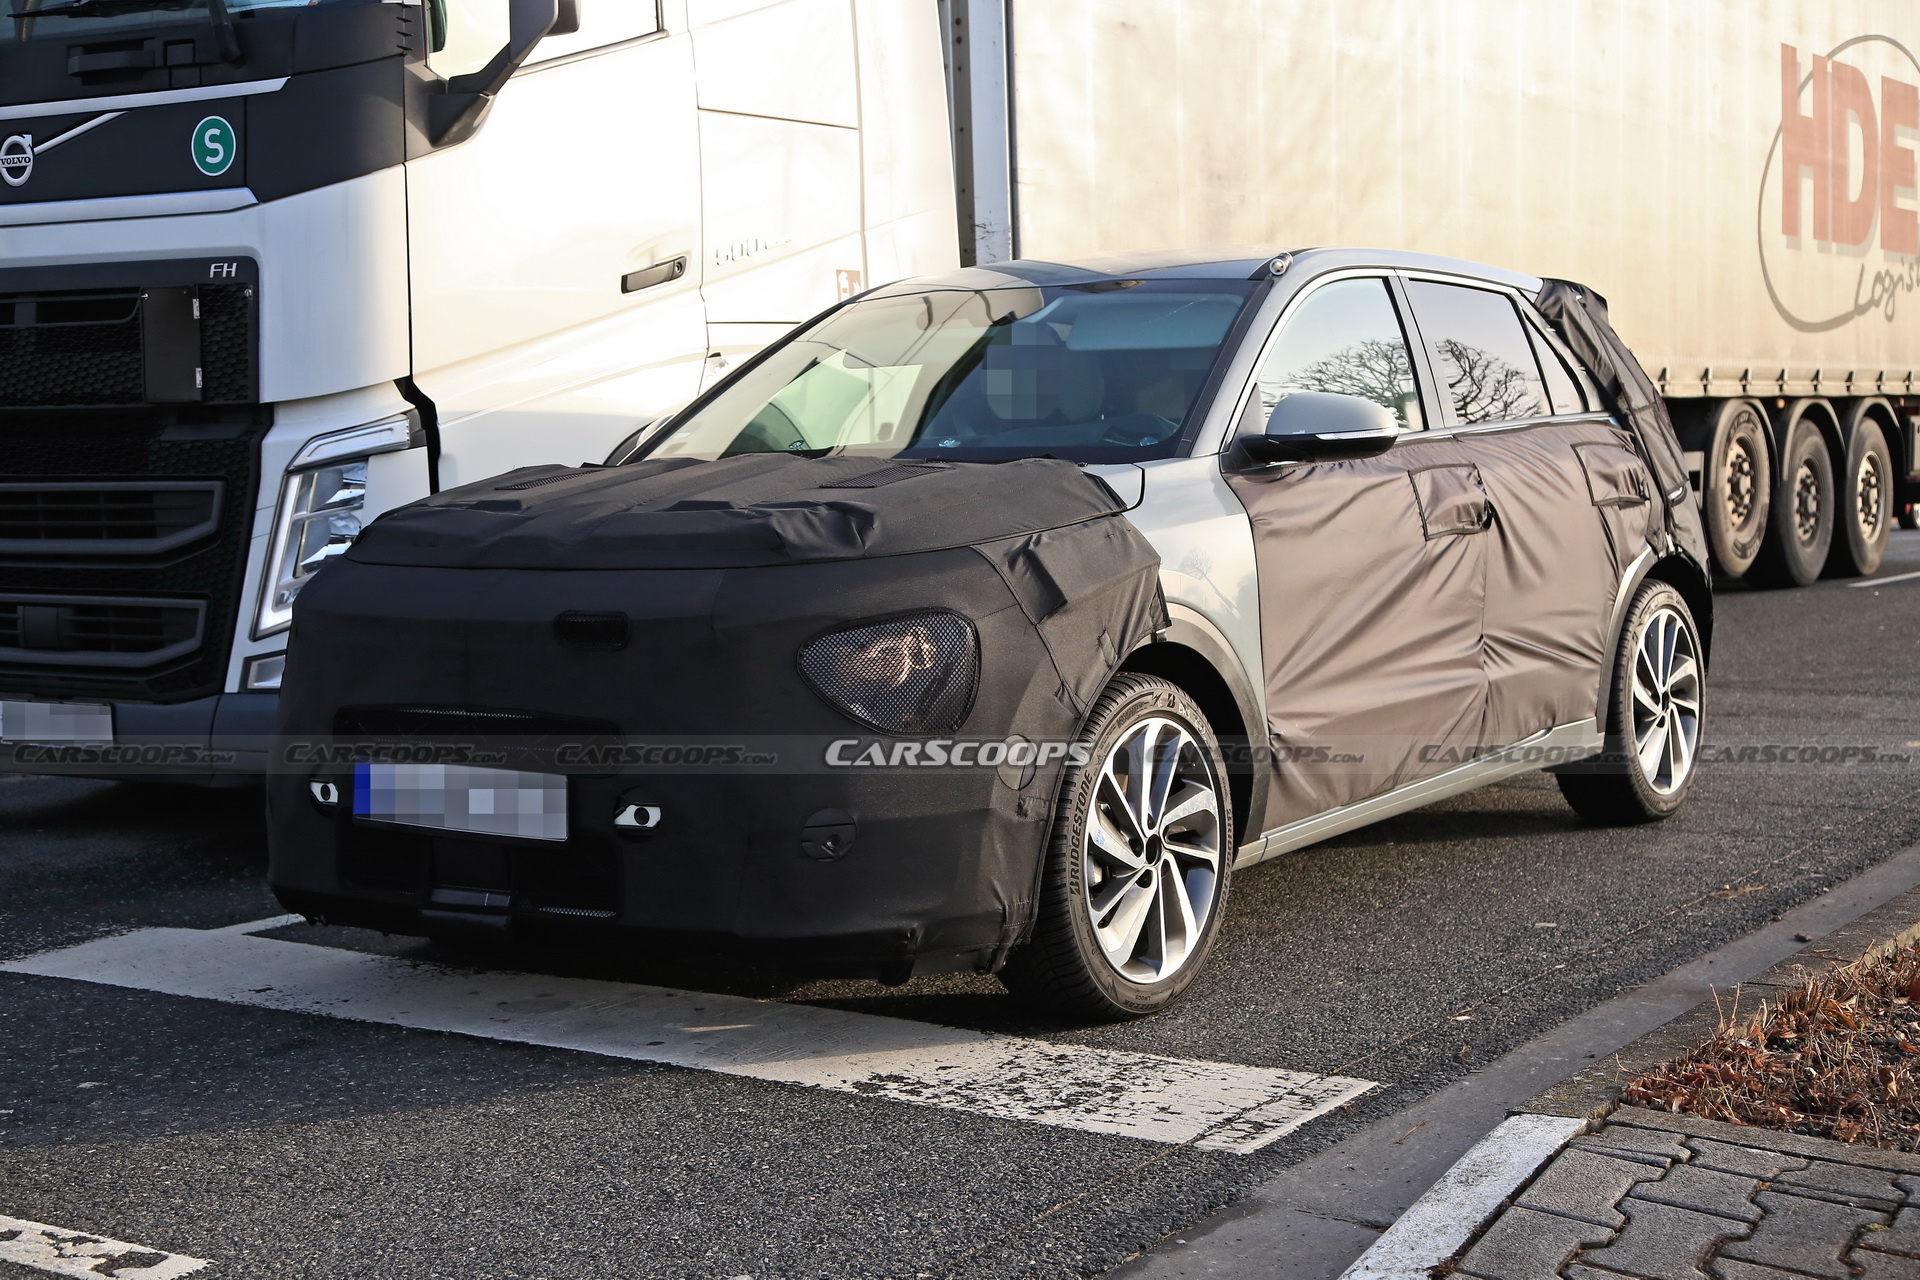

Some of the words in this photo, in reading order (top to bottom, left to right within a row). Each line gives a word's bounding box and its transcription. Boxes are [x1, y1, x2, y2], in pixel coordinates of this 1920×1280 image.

[204, 128, 224, 164] S
[0, 156, 31, 166] VOLVO
[209, 262, 237, 279] FH
[1069, 770, 1093, 896] BRIDGESTONE
